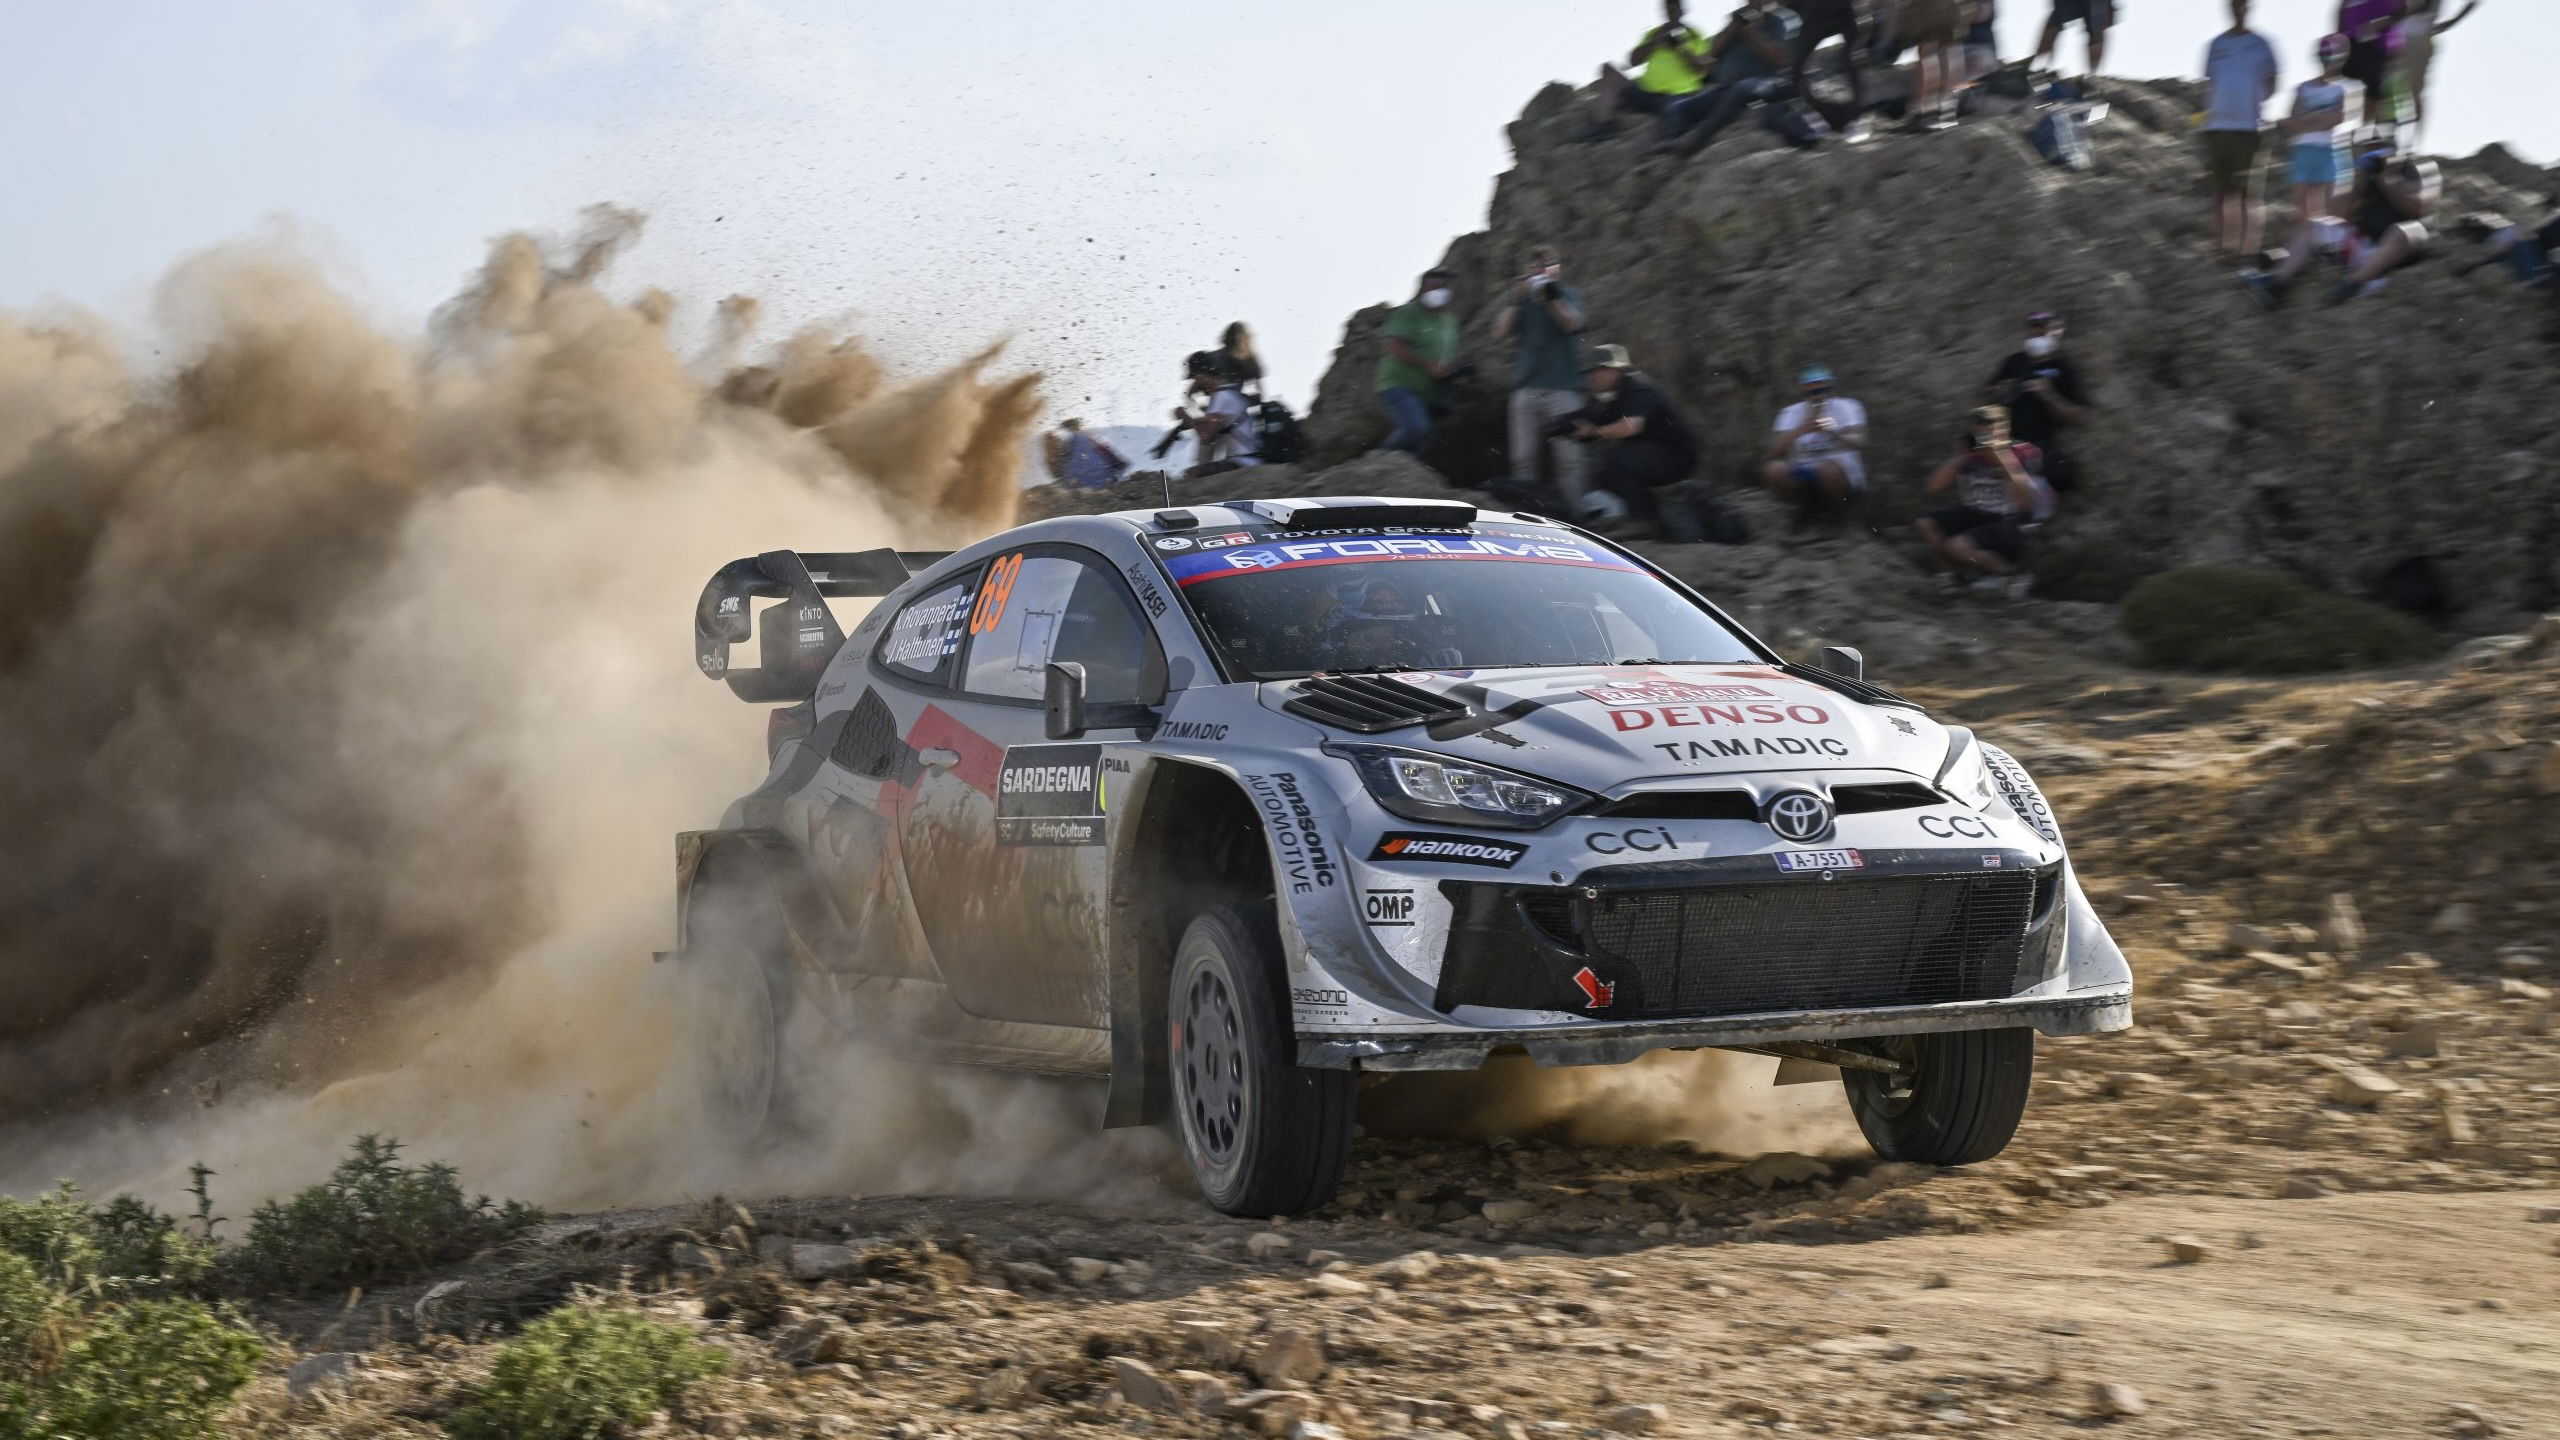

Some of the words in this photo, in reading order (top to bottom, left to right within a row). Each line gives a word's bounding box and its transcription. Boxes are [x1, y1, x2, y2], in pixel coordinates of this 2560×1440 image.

[1202, 535, 1250, 548] GR
[1261, 527, 1377, 540] TOYOTA
[1383, 526, 1482, 536] GAZOO
[1487, 529, 1576, 545] Racing
[1280, 539, 1594, 562] FORUM8
[969, 553, 1024, 635] 69
[1607, 704, 1830, 732] DENSO
[1161, 721, 1229, 741] TAMADIC
[1654, 737, 1849, 761] TAMADIC
[1105, 758, 1131, 773] PIAA
[1002, 766, 1091, 793] SARDEGNA
[1031, 822, 1092, 842] SafetyCulture
[1242, 774, 1313, 894] AUTOMOTIVE
[1269, 772, 1337, 888] Panasonic
[1794, 852, 1848, 867] A-7551
[1366, 895, 1415, 919] OMP
